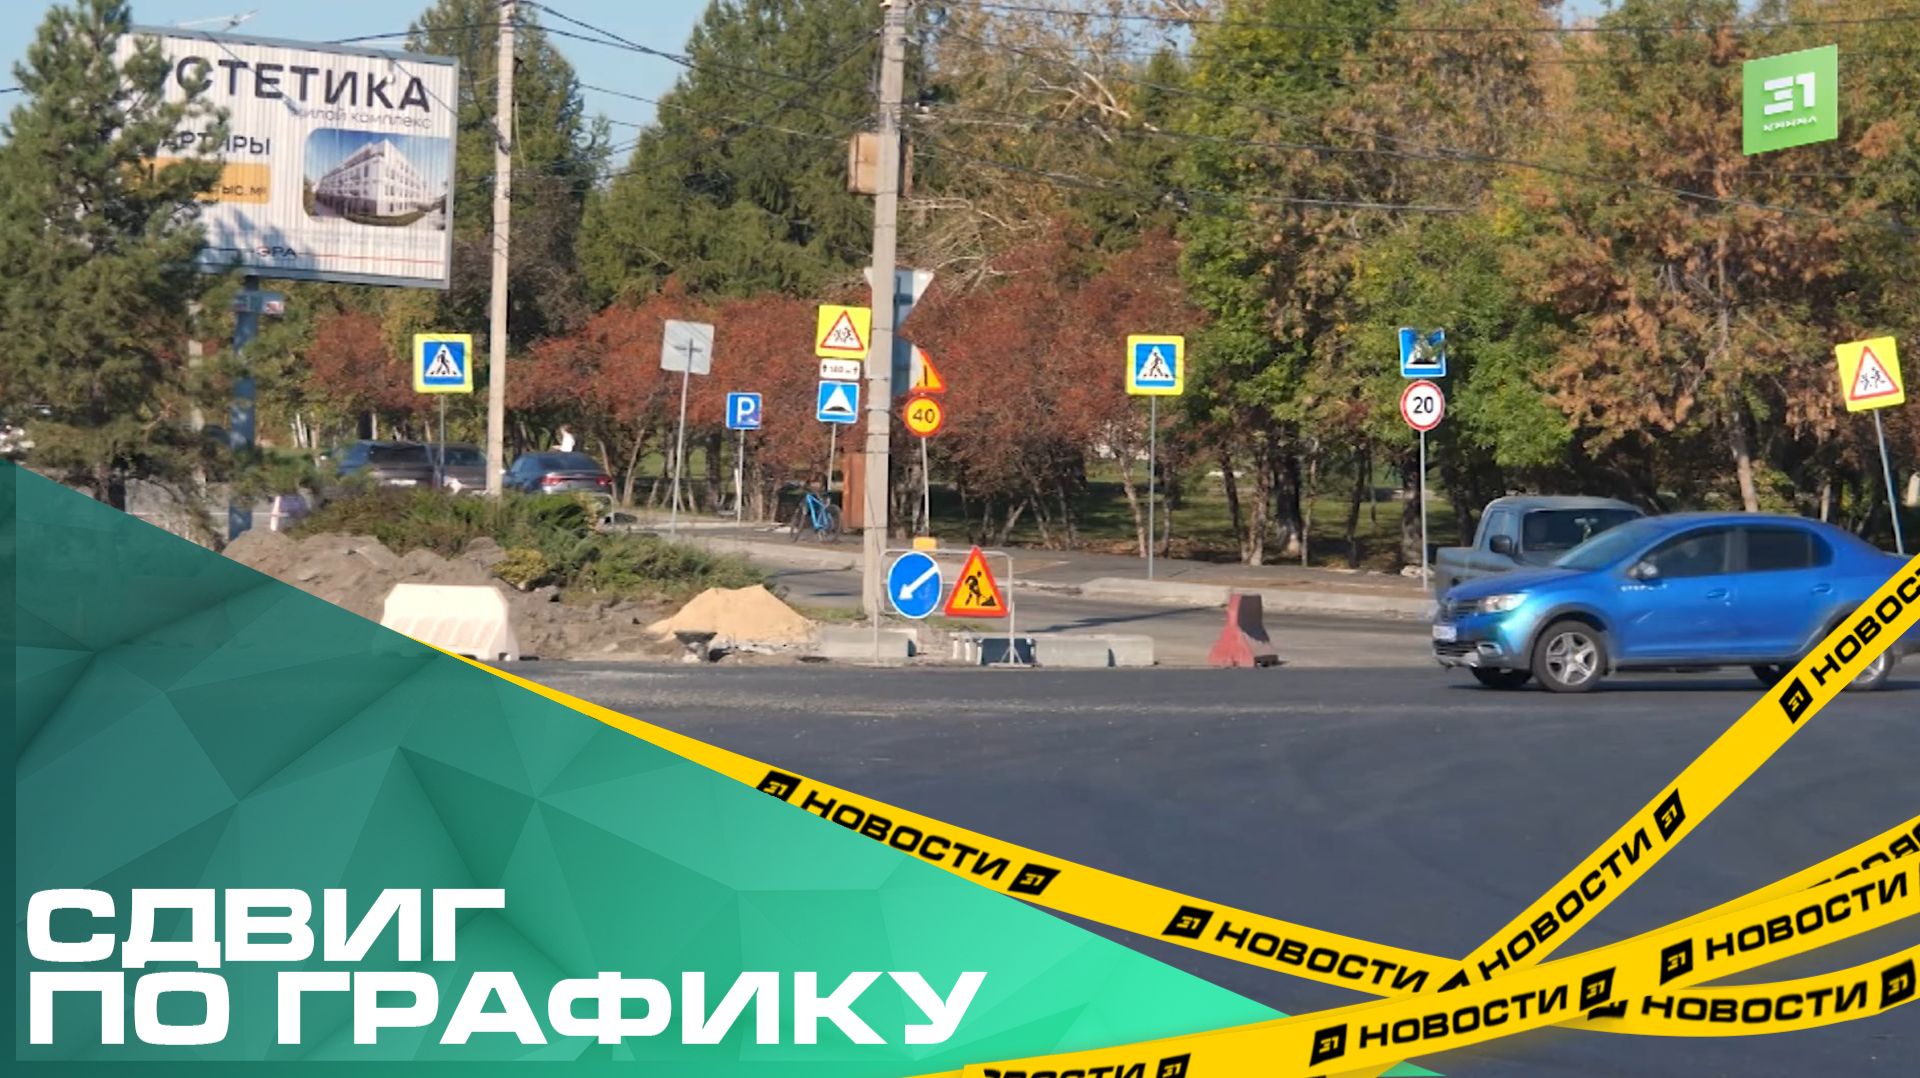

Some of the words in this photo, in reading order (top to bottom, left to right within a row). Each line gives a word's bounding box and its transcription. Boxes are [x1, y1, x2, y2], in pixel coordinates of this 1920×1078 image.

[176, 56, 430, 112] СТЕТИКА
[351, 112, 432, 129] комплекс
[737, 396, 756, 425] P
[1413, 396, 1434, 414] 20
[912, 408, 936, 424] 40
